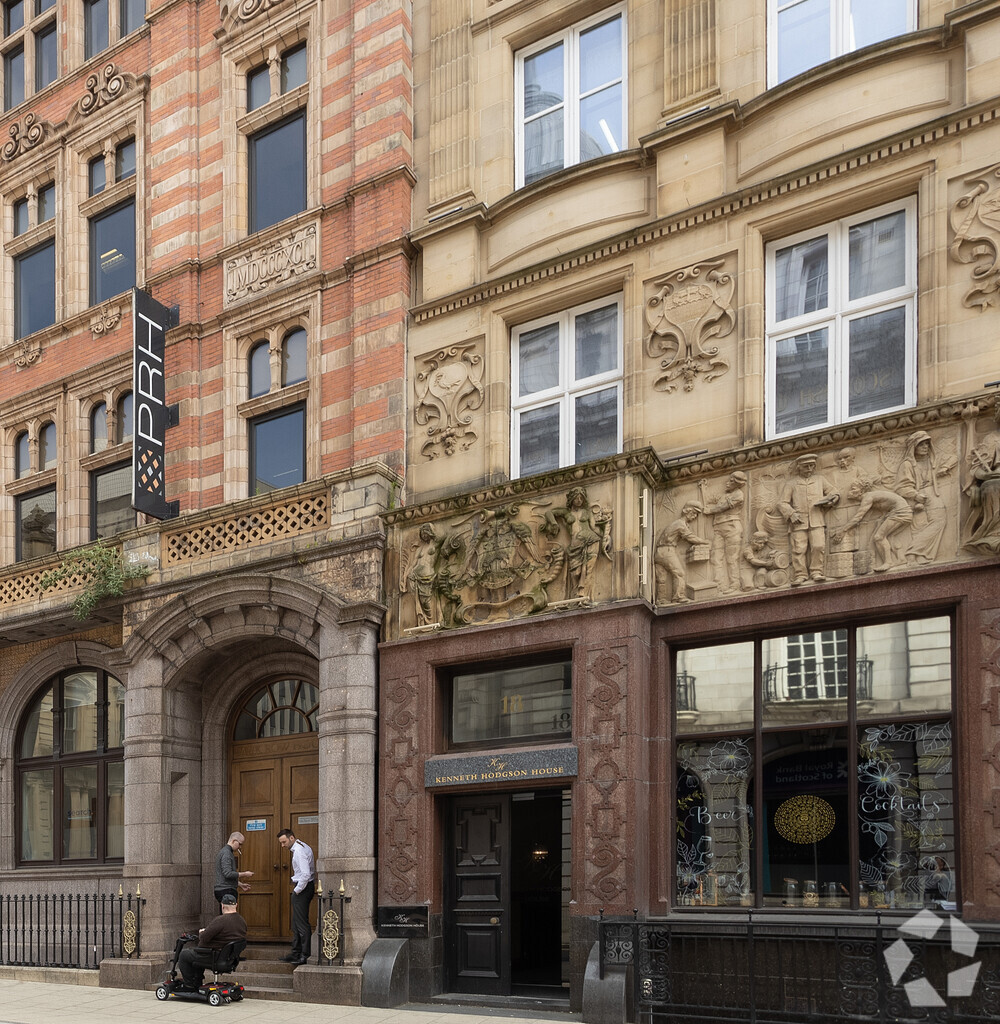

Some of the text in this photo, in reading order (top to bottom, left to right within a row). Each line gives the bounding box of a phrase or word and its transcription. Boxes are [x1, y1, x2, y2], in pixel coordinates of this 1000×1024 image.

[138, 312, 163, 447] PRH
[500, 694, 523, 714] 18
[435, 766, 564, 783] KENNETH HODGSON HOUSE
[860, 792, 945, 815] Cocktails
[684, 806, 742, 826] Beer
